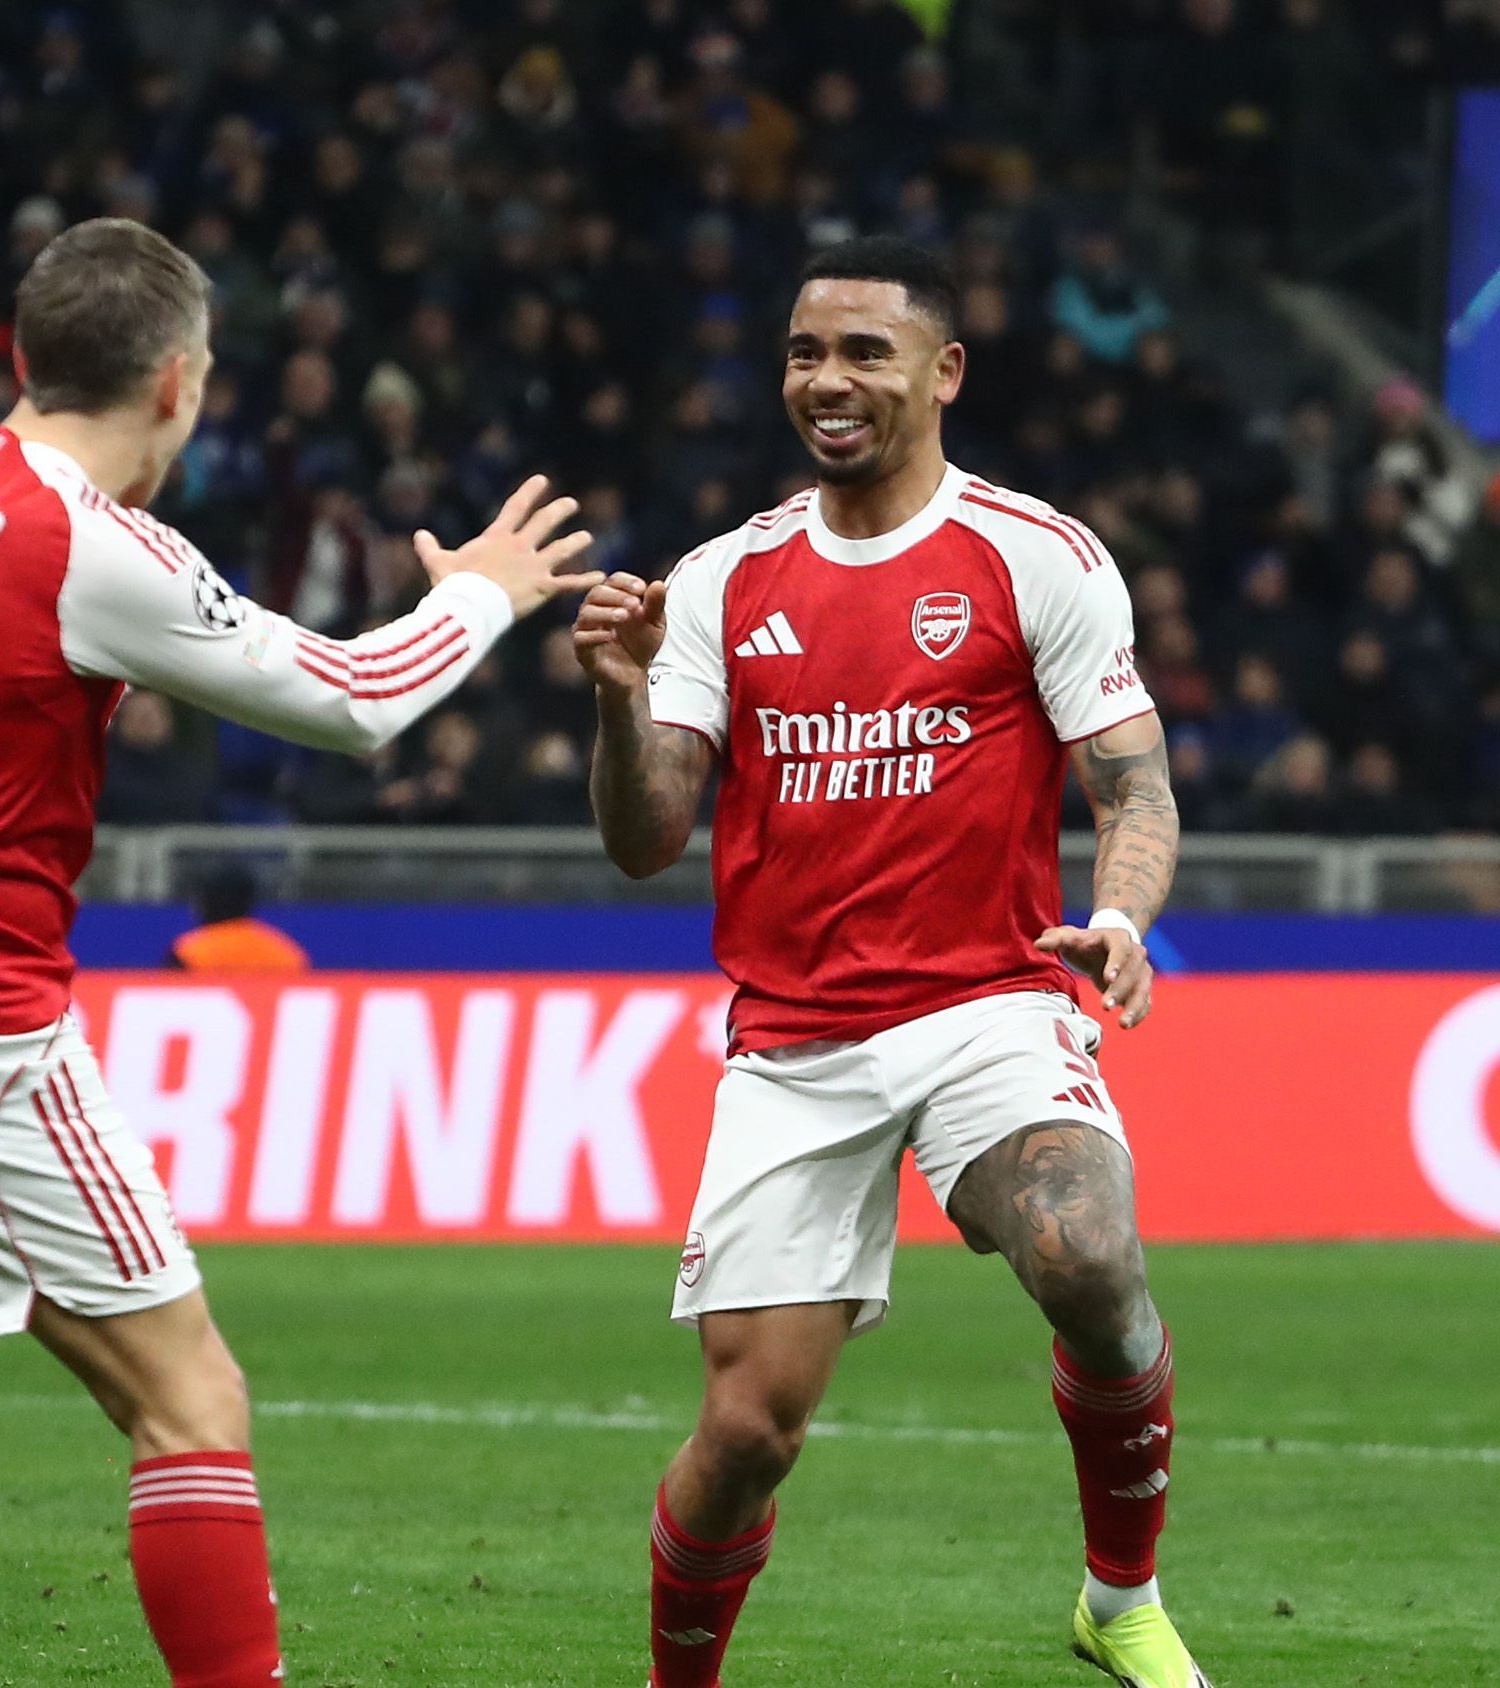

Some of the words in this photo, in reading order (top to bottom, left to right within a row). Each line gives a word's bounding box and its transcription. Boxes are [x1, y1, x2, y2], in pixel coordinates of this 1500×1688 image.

[921, 603, 962, 616] Arsenal
[755, 700, 972, 757] Emirates
[778, 760, 822, 803] FLY
[825, 753, 935, 801] BETTER
[71, 987, 730, 1227] RINK
